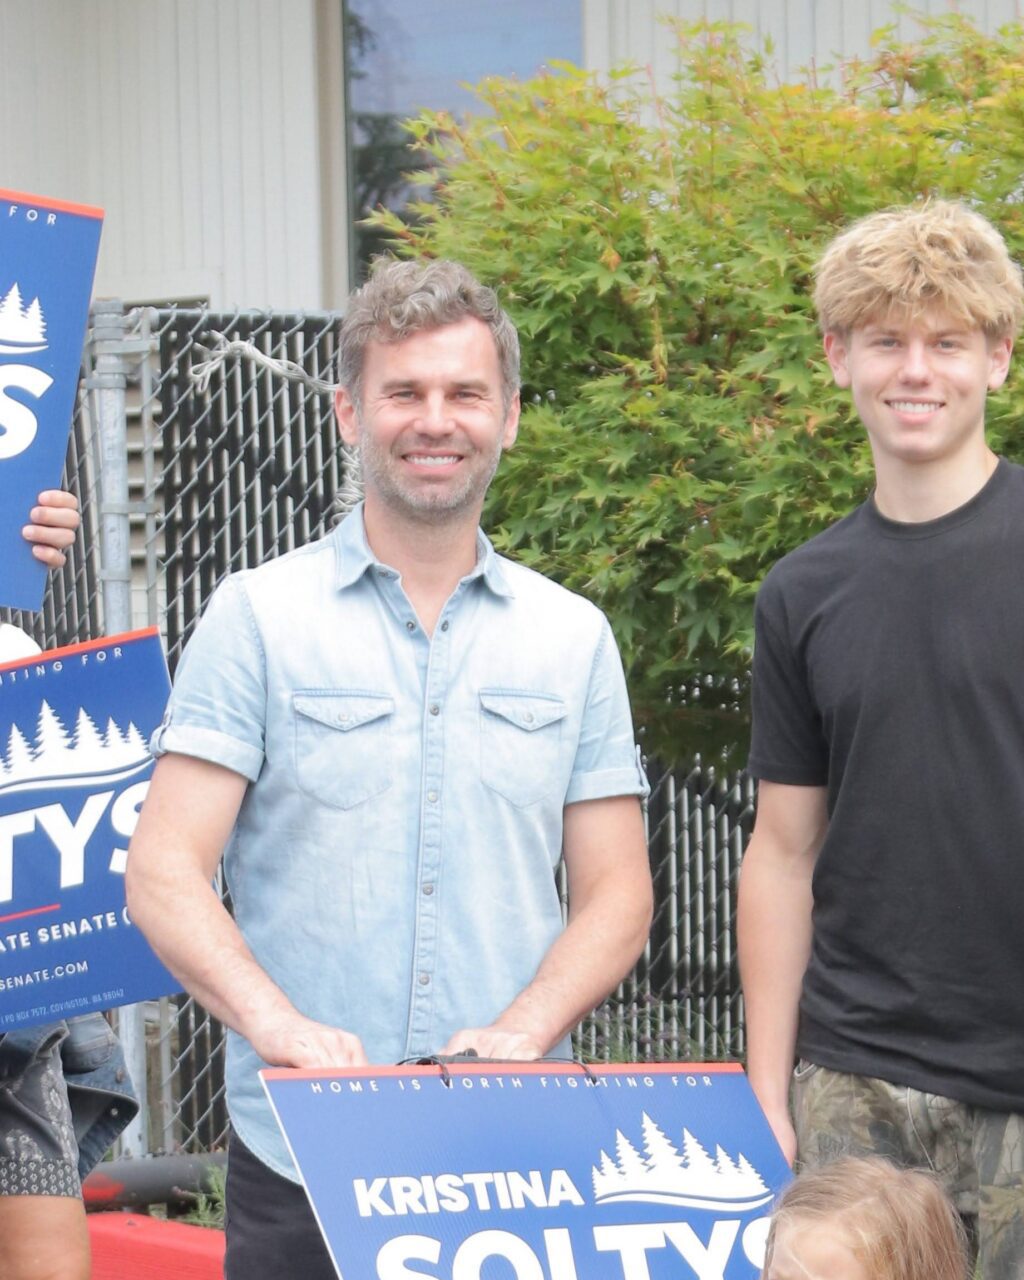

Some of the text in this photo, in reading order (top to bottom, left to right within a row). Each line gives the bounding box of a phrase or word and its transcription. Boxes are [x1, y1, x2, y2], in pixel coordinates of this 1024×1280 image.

[9, 205, 57, 225] FOR
[82, 647, 122, 666] FOR
[37, 911, 118, 943] SENATE
[310, 1079, 380, 1094] HOME
[399, 1078, 422, 1091] IS
[540, 1076, 655, 1089] FIGHTING
[671, 1075, 713, 1088] FOR
[353, 1169, 585, 1217] KRISTINA
